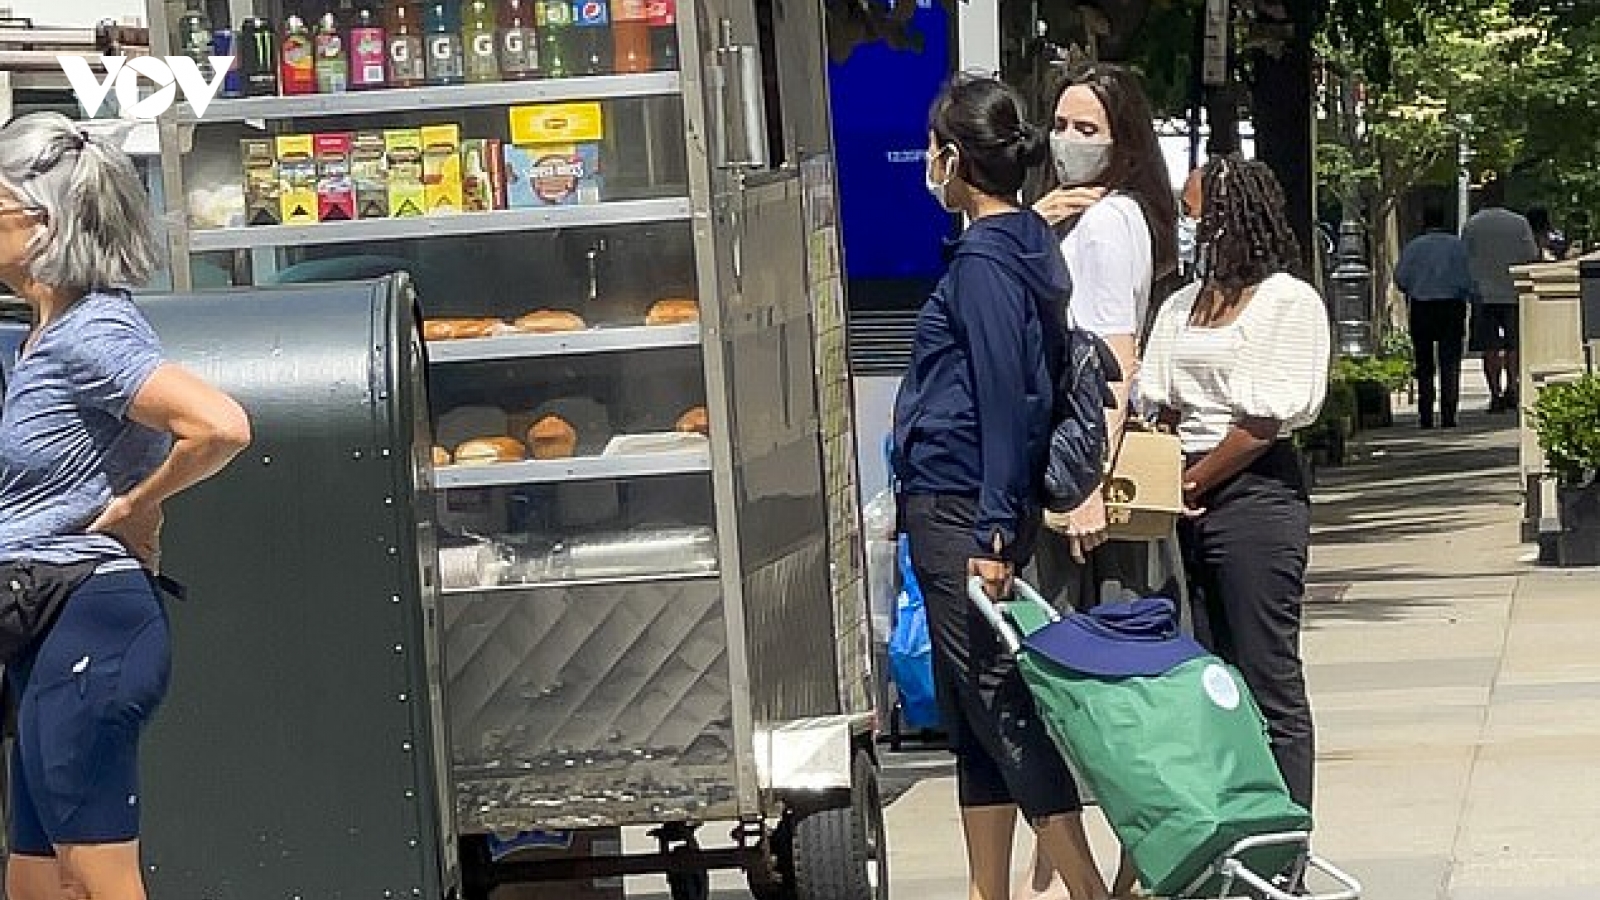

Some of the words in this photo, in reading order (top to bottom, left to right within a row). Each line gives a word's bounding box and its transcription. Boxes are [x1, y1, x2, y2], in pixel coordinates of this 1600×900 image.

[391, 40, 407, 61] G
[433, 37, 449, 59] G
[474, 35, 492, 55] G
[505, 32, 522, 51] G
